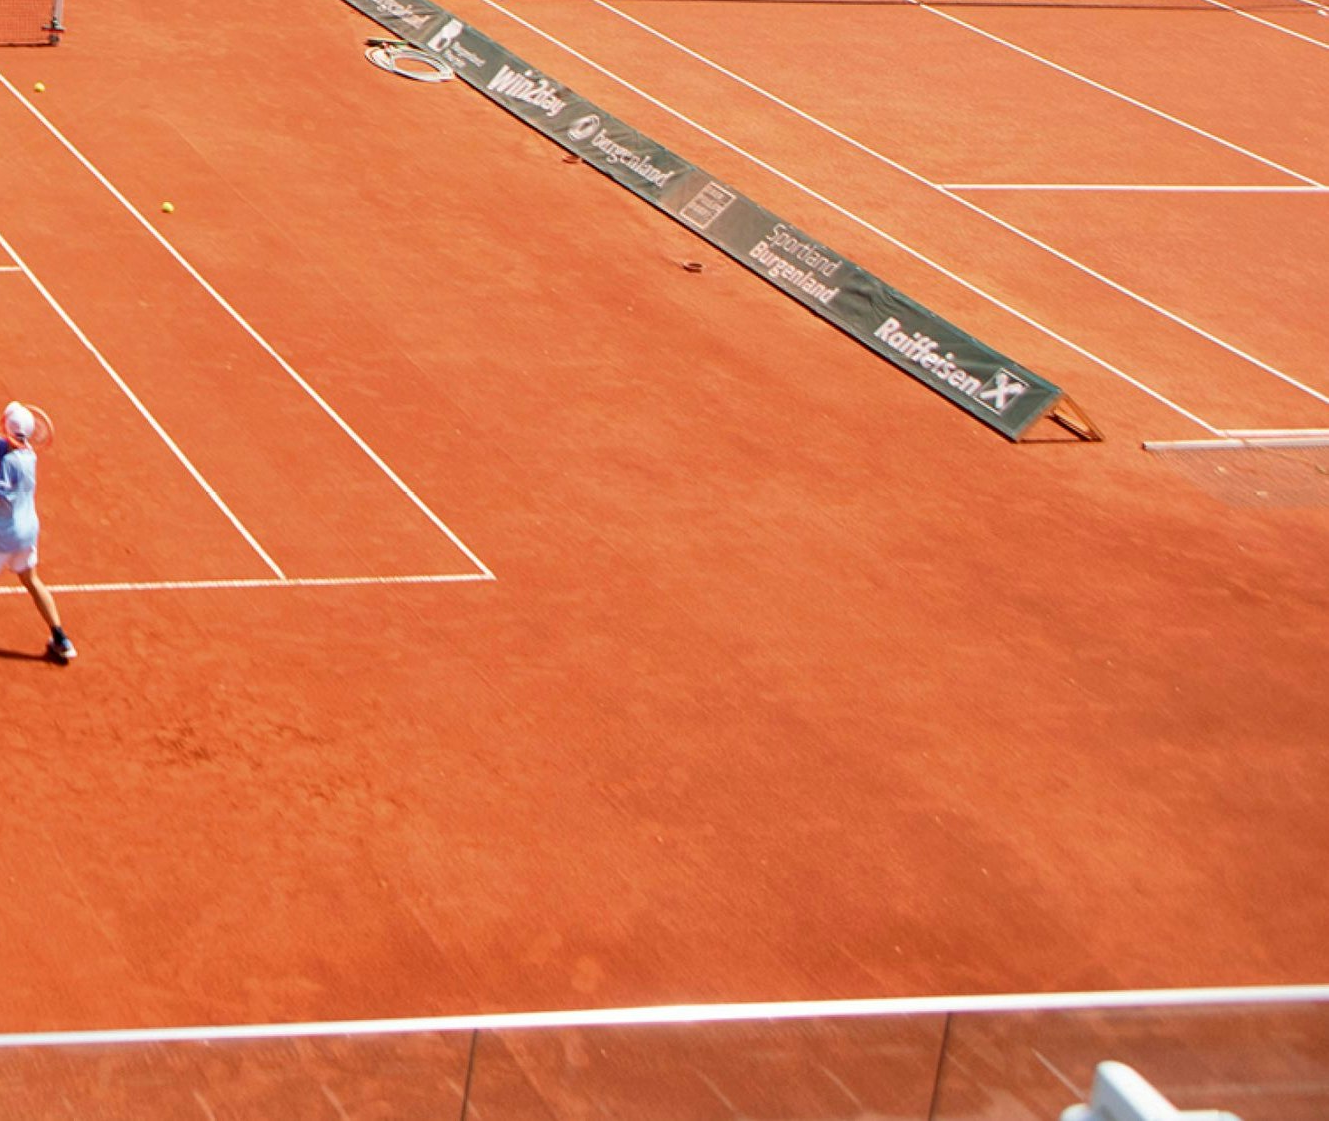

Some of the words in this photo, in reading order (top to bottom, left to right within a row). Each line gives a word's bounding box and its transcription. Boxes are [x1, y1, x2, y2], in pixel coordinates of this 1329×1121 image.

[486, 63, 567, 117] win2day
[591, 128, 676, 189] burgenland
[748, 240, 841, 305] Burgenland
[766, 222, 843, 278] Sportland
[873, 316, 982, 397] Raiffeisen
